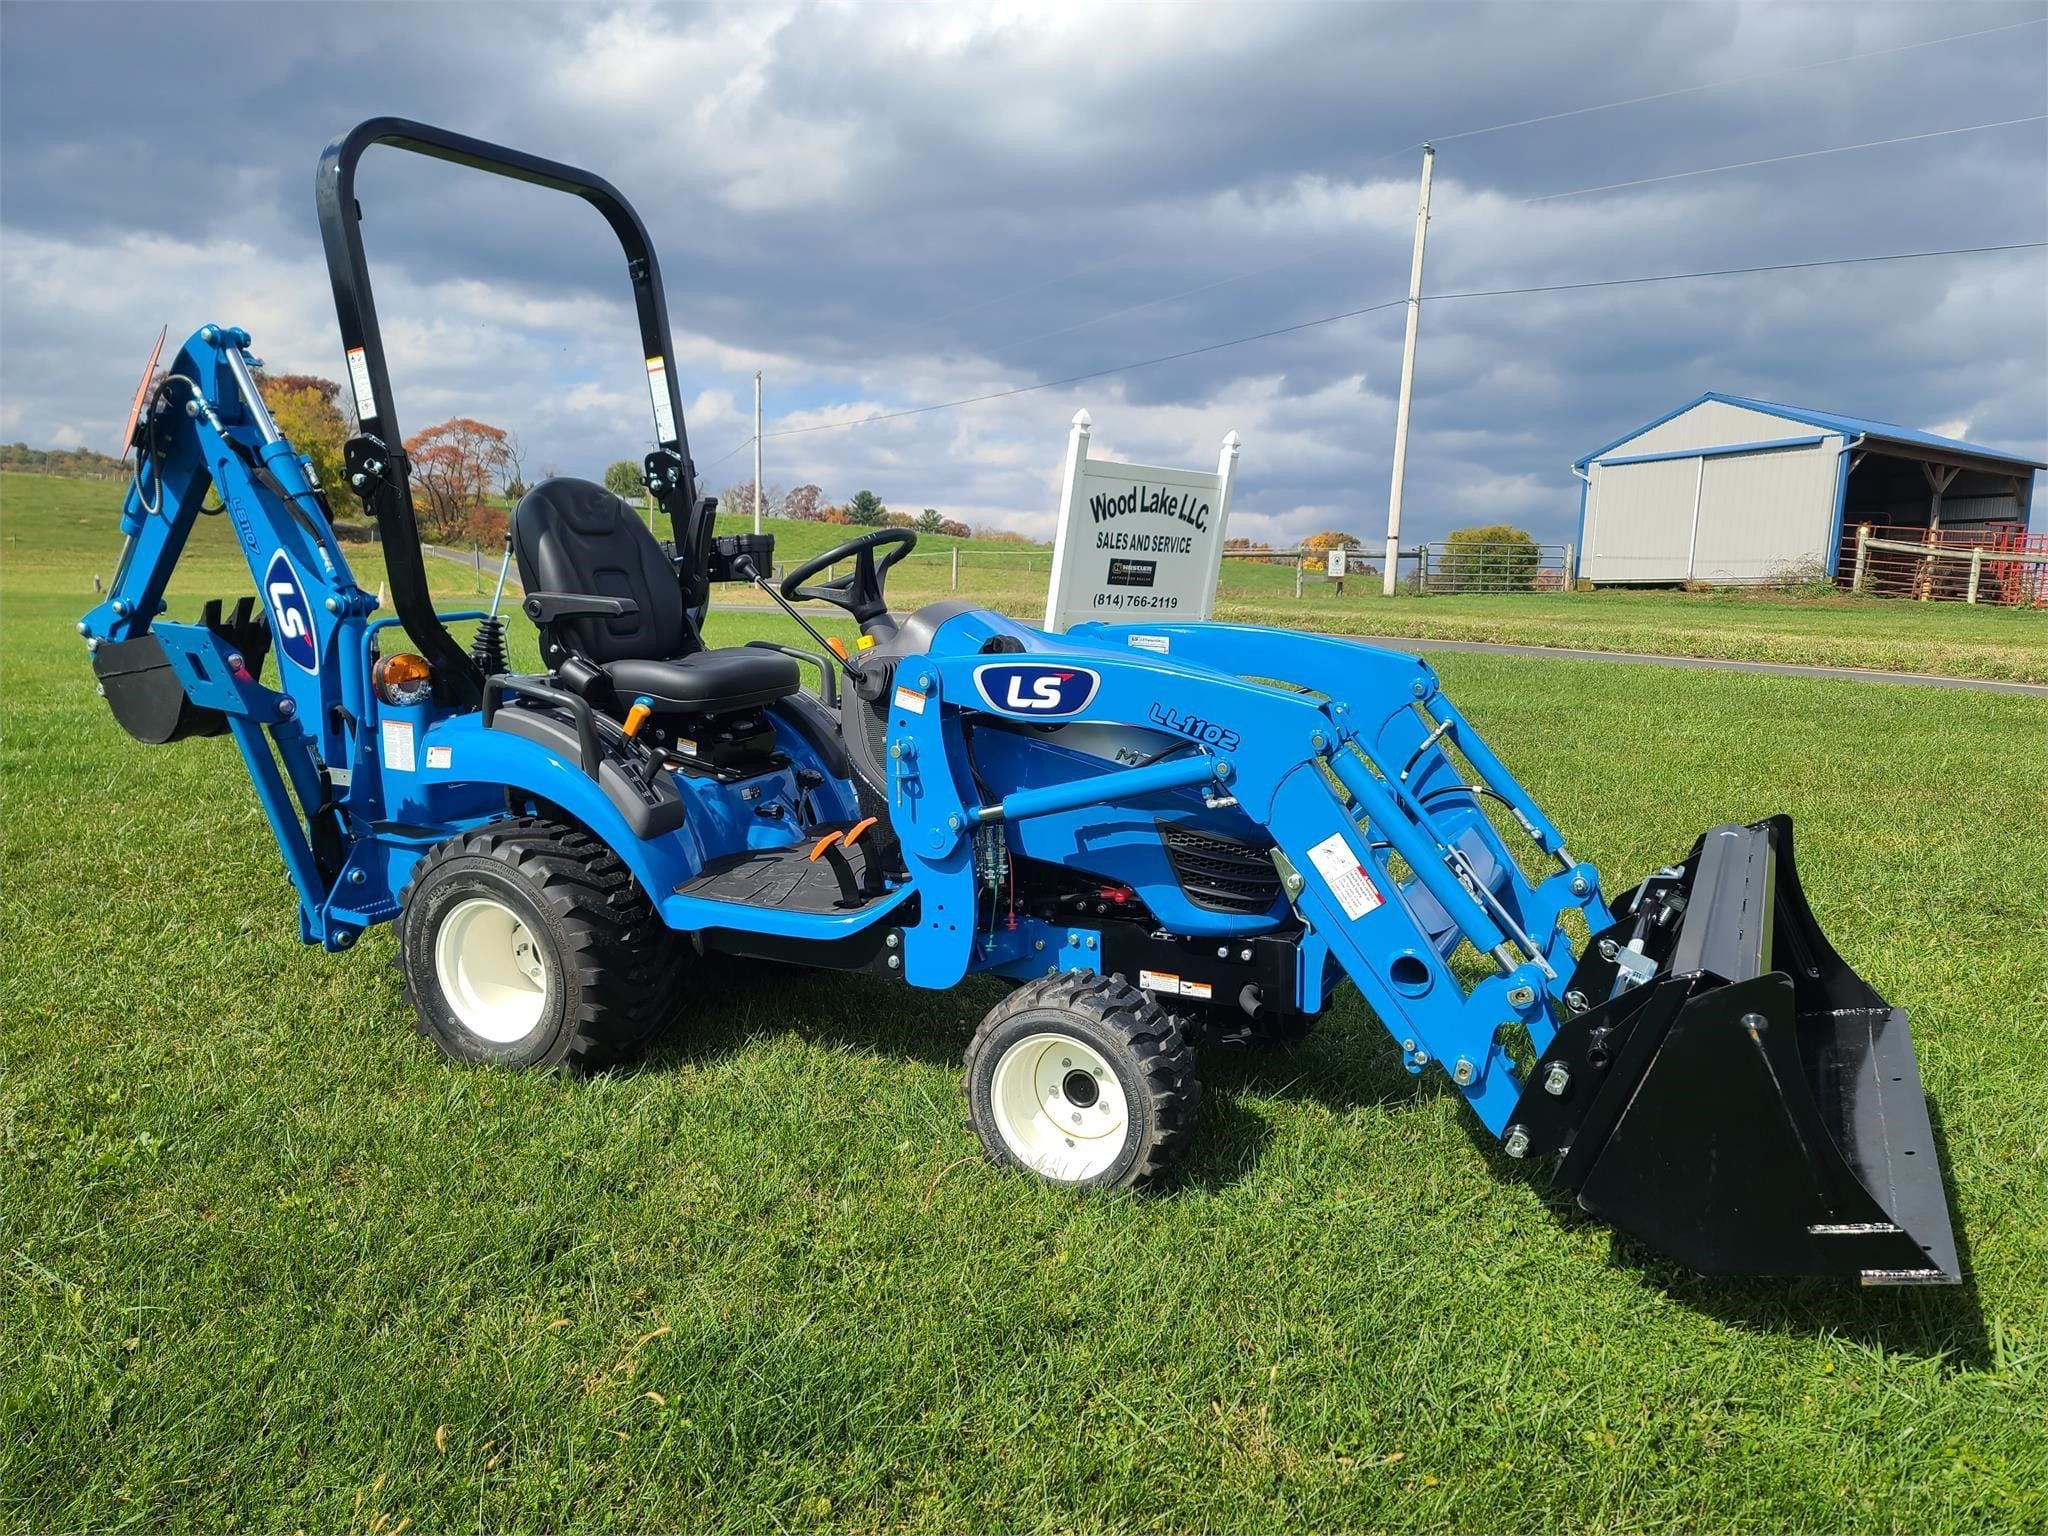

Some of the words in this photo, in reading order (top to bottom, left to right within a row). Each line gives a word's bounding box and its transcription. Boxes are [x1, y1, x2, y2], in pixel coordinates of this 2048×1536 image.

[1089, 486, 1137, 524] Wood
[1140, 485, 1178, 517] Lake
[1096, 531, 1129, 551] SALES
[1130, 533, 1150, 551] AND
[1151, 535, 1192, 554] SERVICE
[269, 582, 306, 638] LS
[1093, 593, 1124, 609] (814)
[1126, 595, 1178, 608] 766-2119
[1007, 675, 1062, 709] LS
[1148, 702, 1240, 752] LL1102
